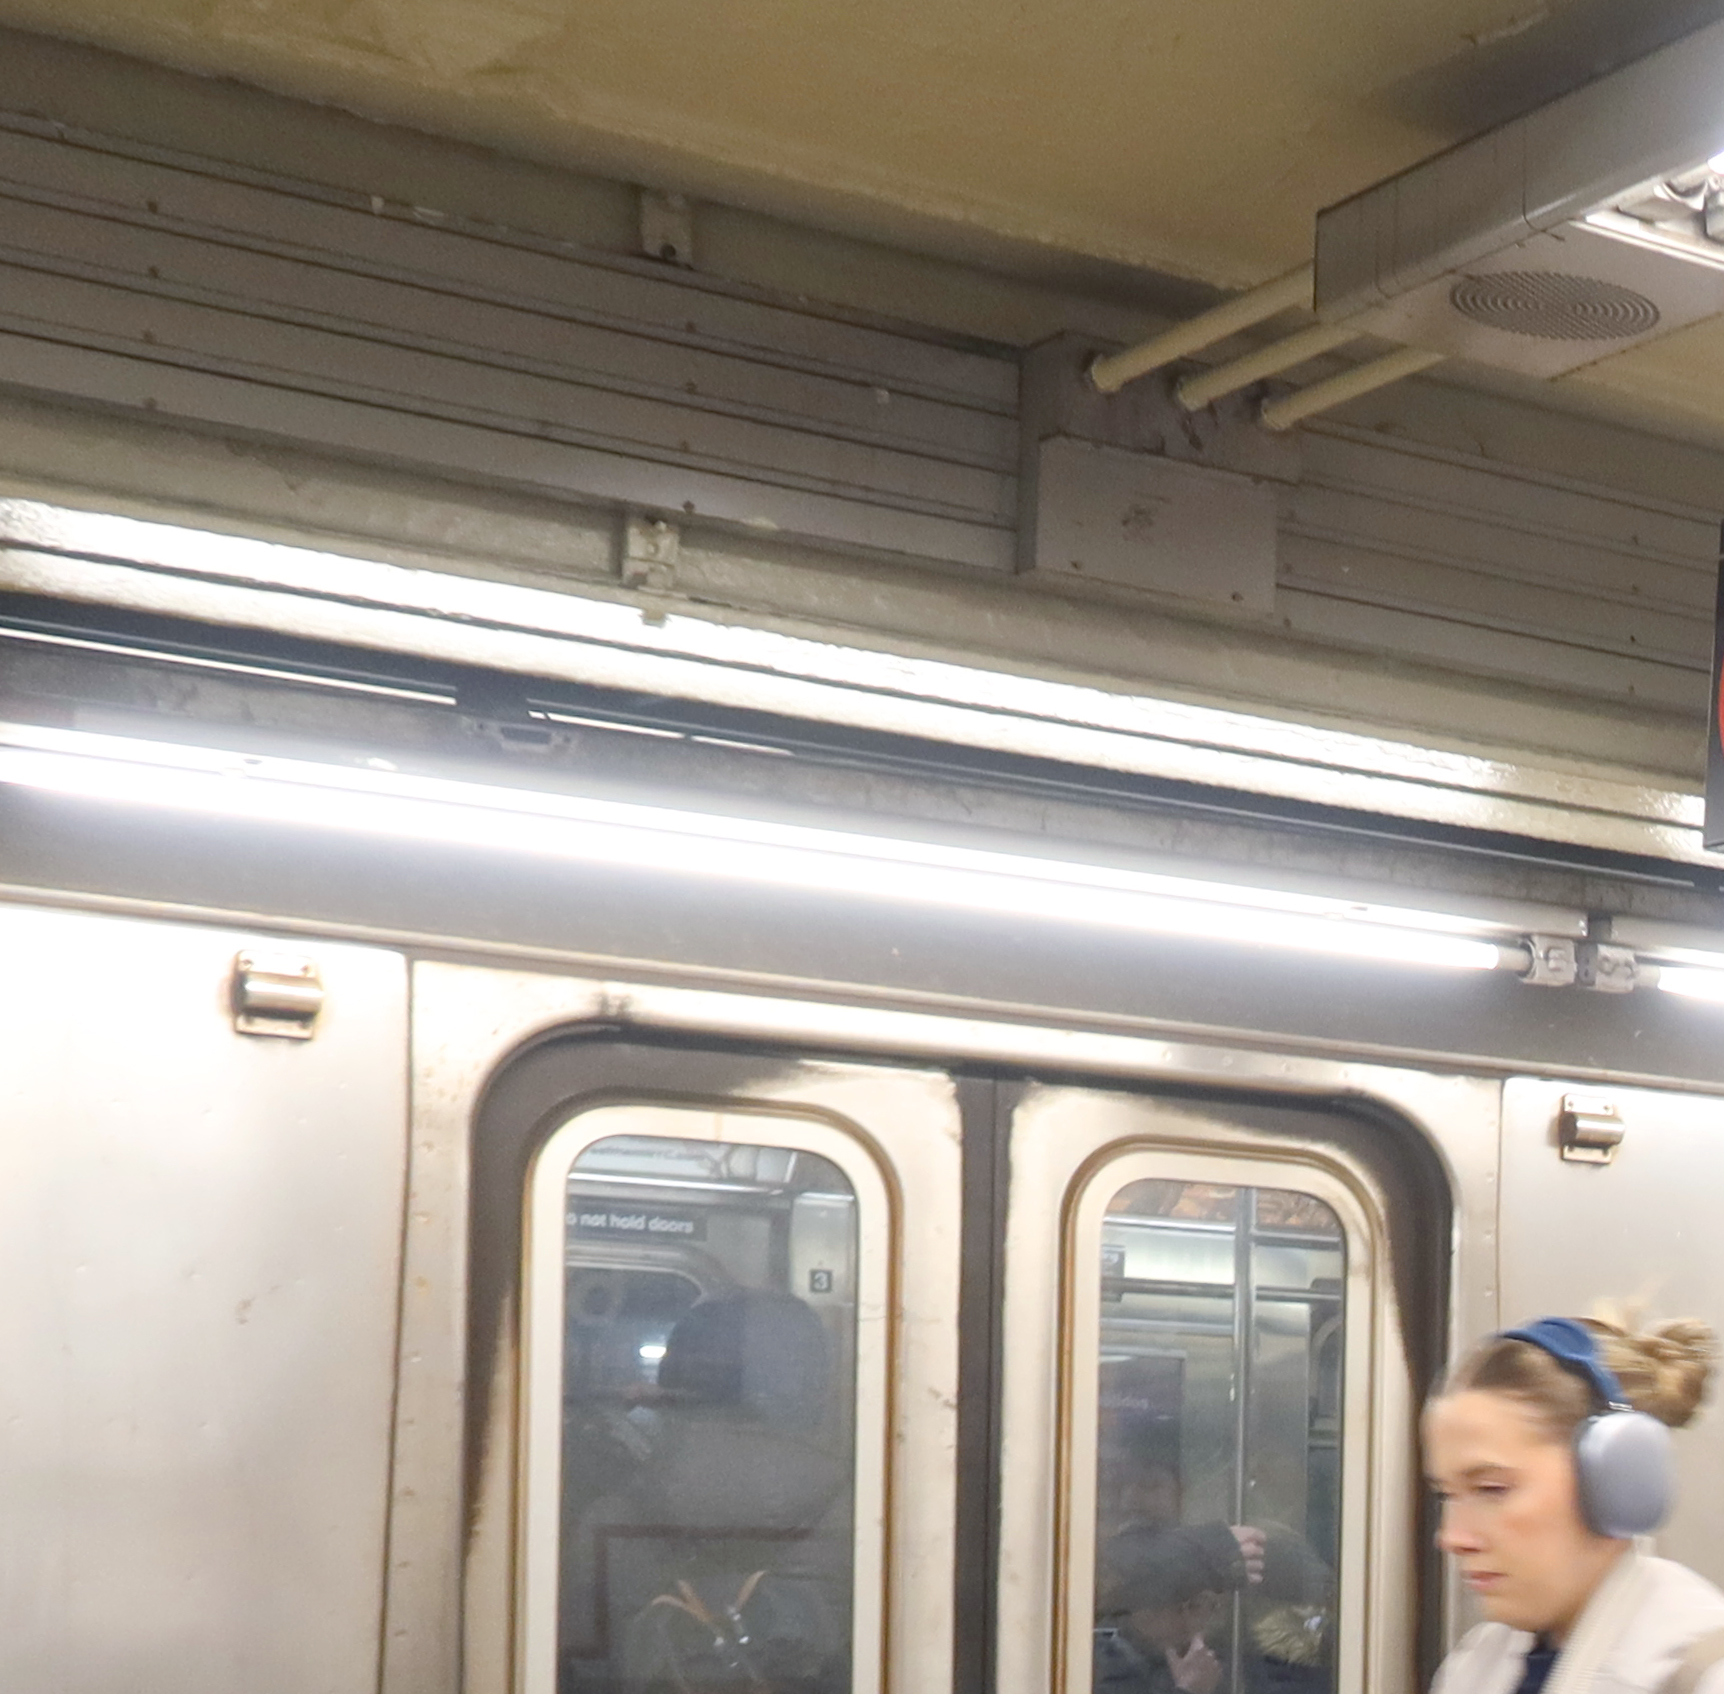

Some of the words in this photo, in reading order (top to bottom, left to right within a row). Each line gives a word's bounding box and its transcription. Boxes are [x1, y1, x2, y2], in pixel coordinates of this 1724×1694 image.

[580, 1213, 607, 1228] not
[609, 1213, 646, 1230] hold
[648, 1216, 694, 1234] doors
[813, 1272, 828, 1290] 3
